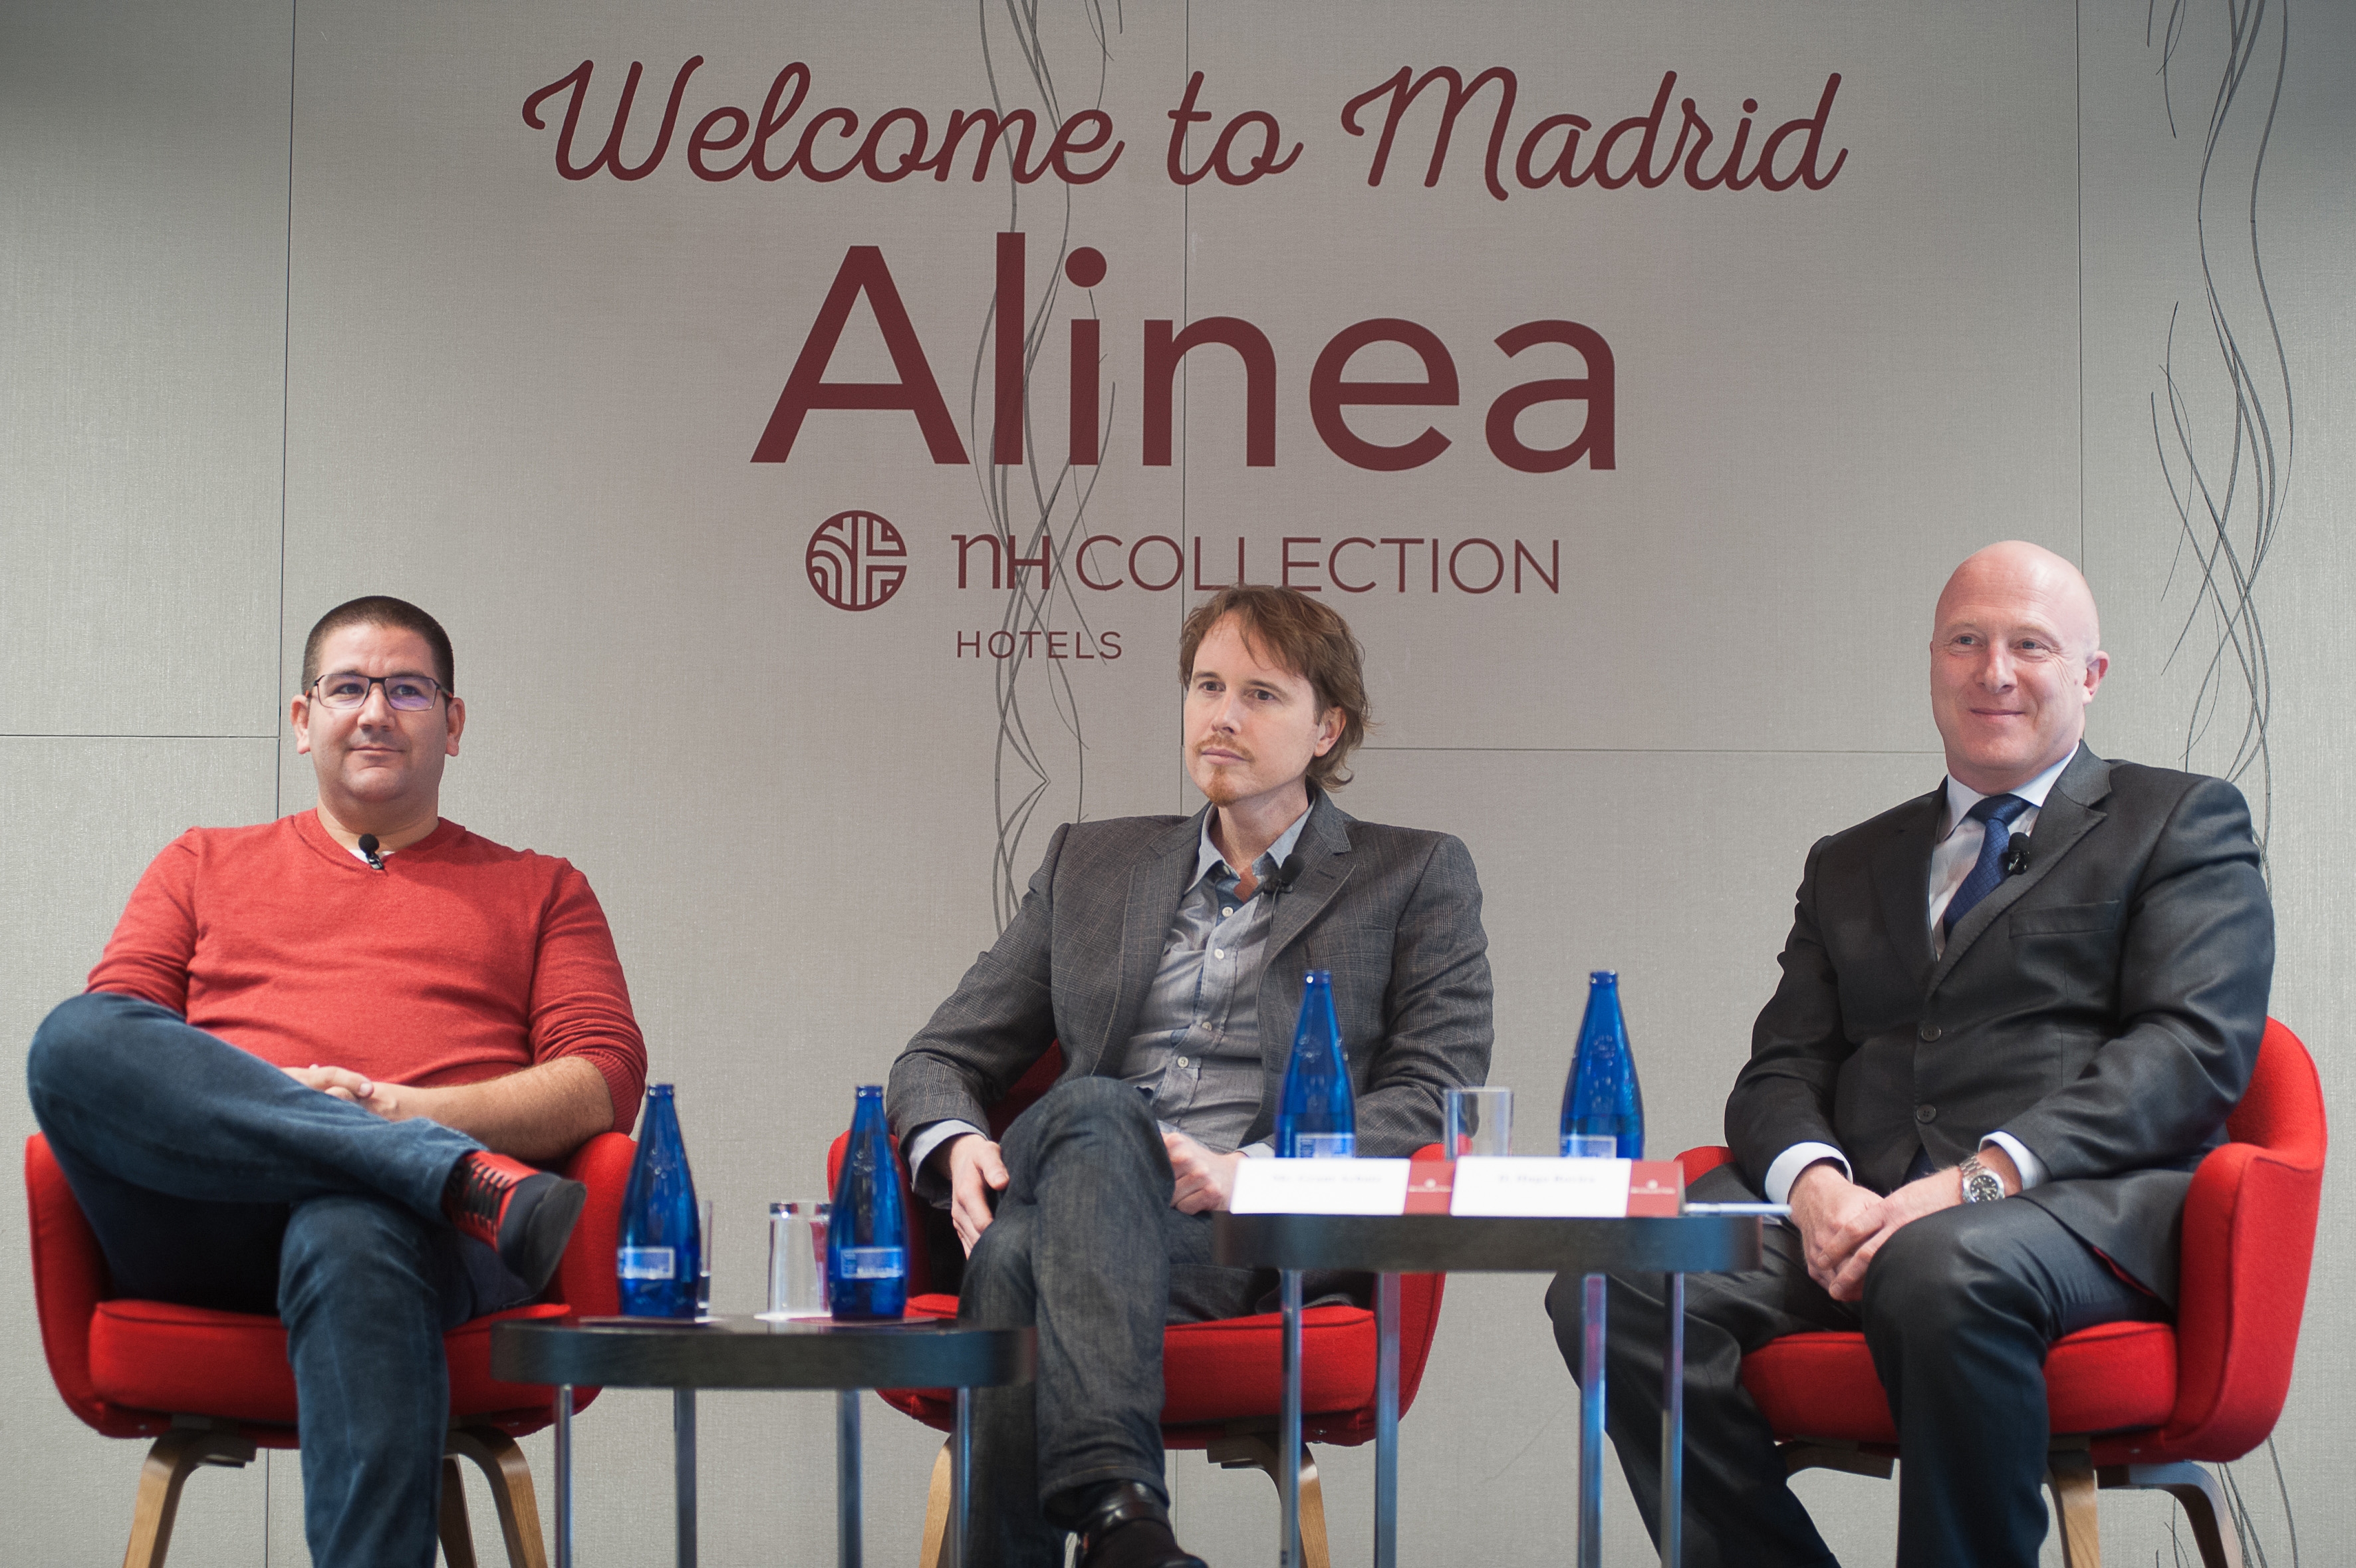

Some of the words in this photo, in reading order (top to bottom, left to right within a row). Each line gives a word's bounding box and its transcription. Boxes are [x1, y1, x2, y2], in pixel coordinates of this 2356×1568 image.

[523, 56, 1125, 186] Welcome
[1167, 72, 1303, 186] to
[1341, 66, 1847, 201] Madrid
[751, 232, 1616, 475] Alinea
[1076, 535, 1559, 594] COLLECTION
[957, 630, 1122, 660] HOTELS
